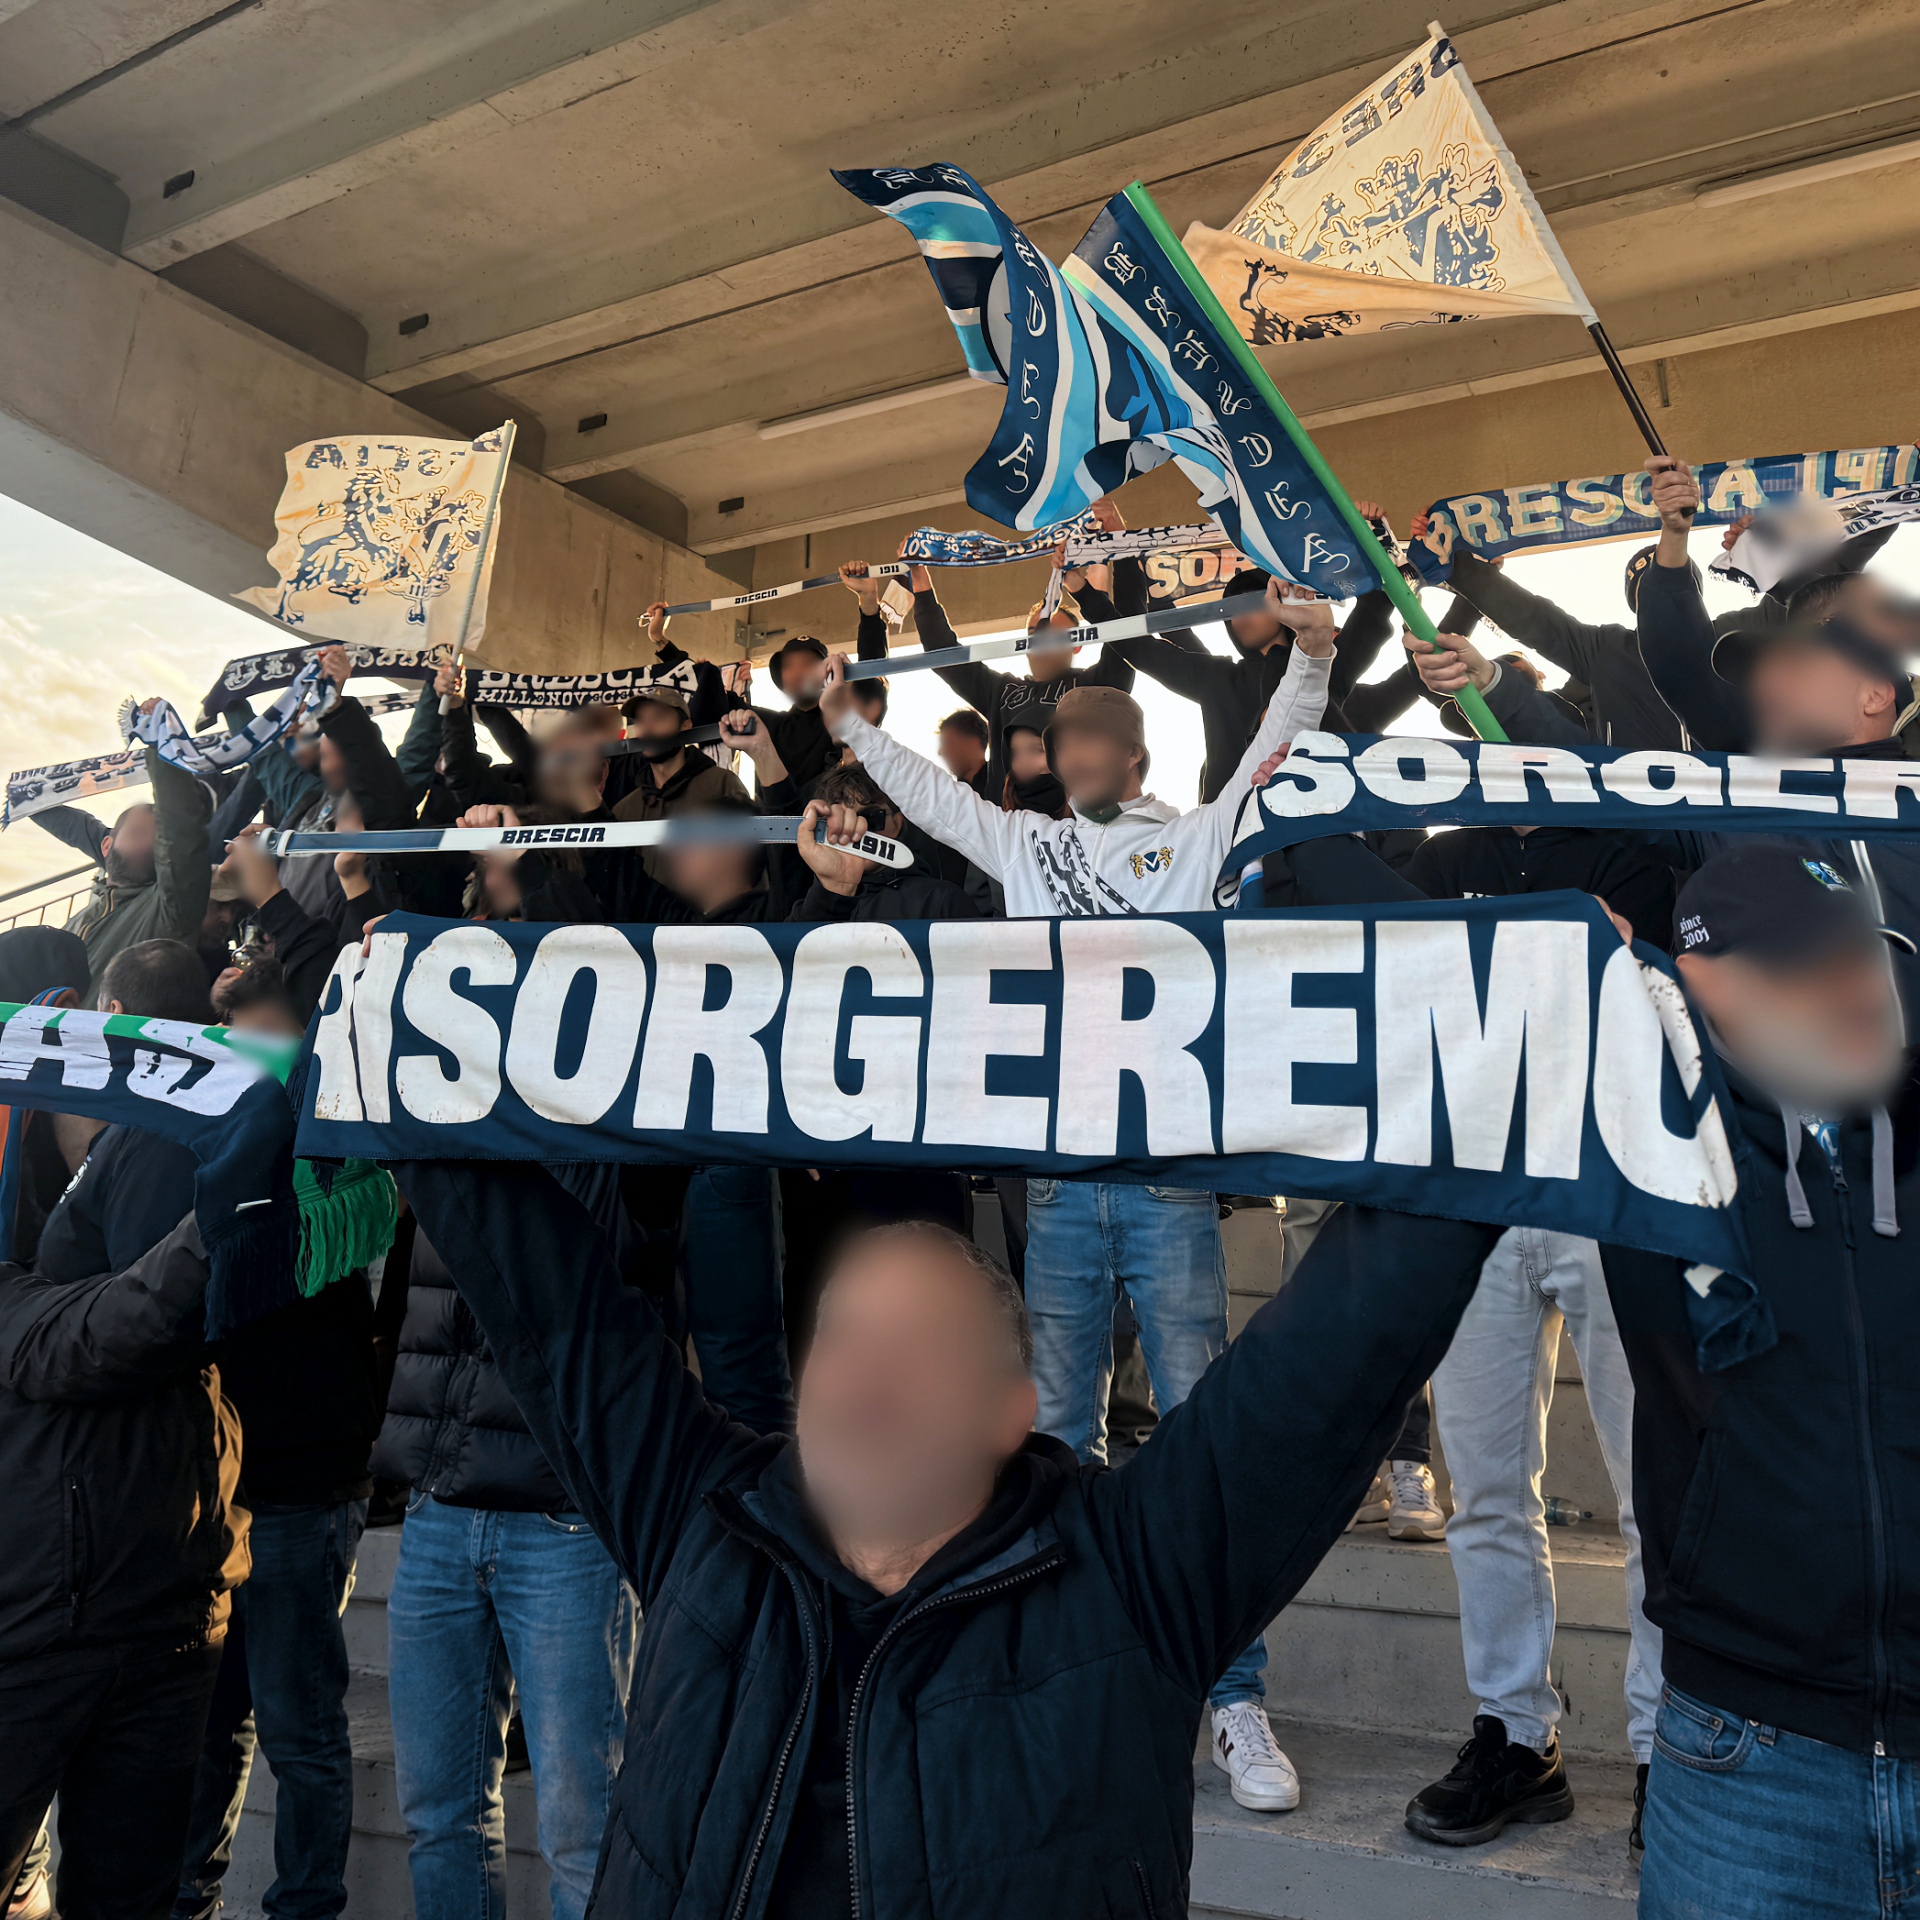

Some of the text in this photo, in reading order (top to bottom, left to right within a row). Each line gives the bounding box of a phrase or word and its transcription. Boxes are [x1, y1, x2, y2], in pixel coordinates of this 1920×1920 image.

[880, 564, 900, 575] 1911
[735, 589, 778, 604] BRESCIA
[500, 827, 606, 845] BRESCIA
[1680, 914, 1703, 935] since
[1682, 926, 1710, 949] 2001
